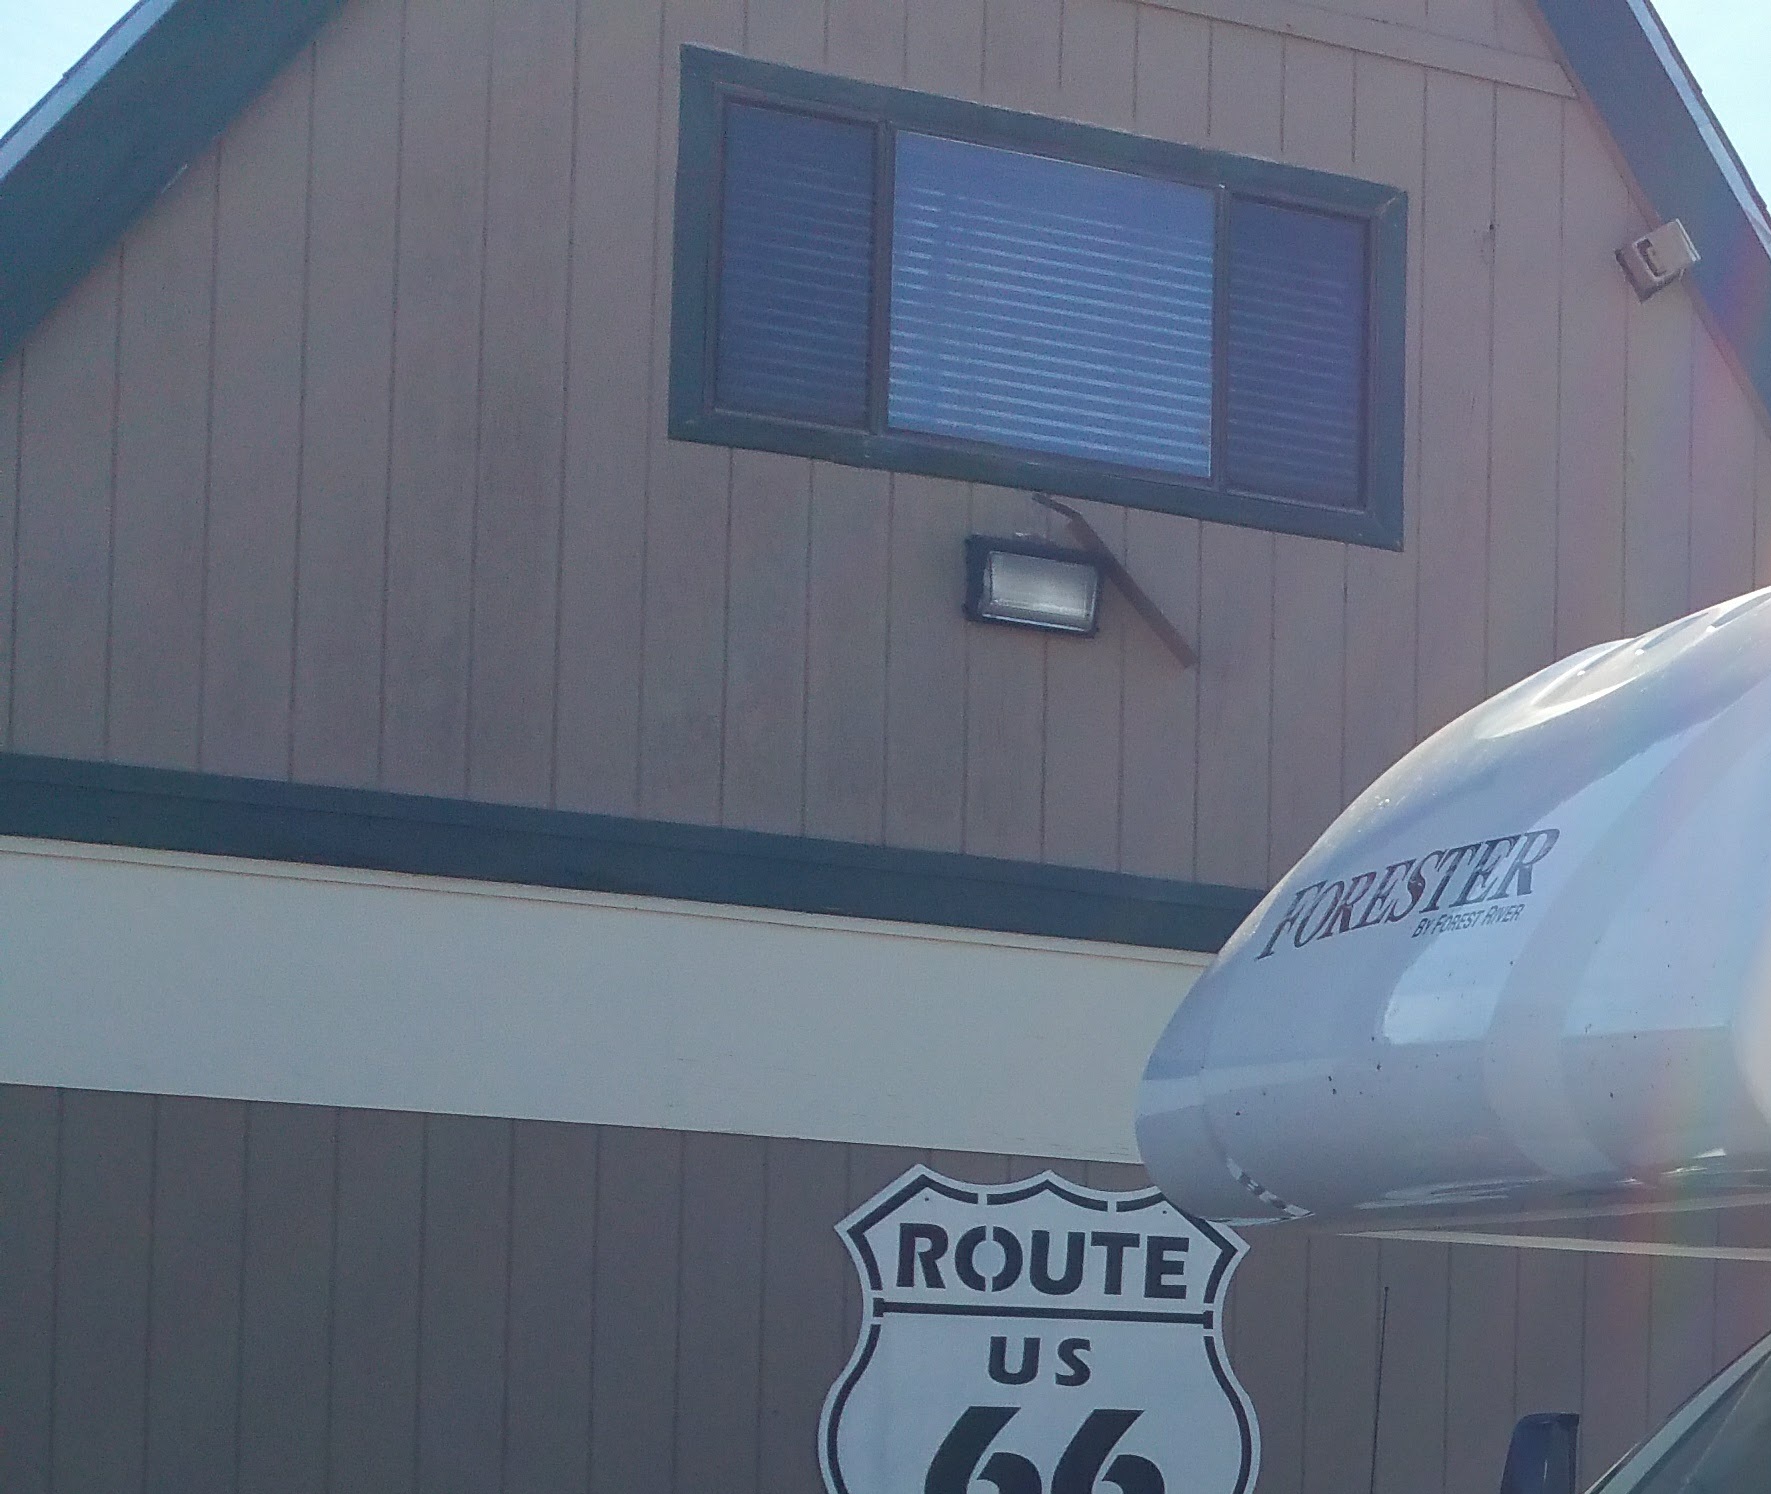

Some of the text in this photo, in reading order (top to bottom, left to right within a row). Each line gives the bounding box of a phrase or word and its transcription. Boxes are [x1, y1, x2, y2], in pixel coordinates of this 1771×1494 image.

[1254, 828, 1561, 961] FORESTER
[1432, 909, 1485, 935] FOREST
[1481, 904, 1526, 928] RIVER
[896, 1222, 1190, 1299] ROUTE
[988, 1336, 1092, 1387] US
